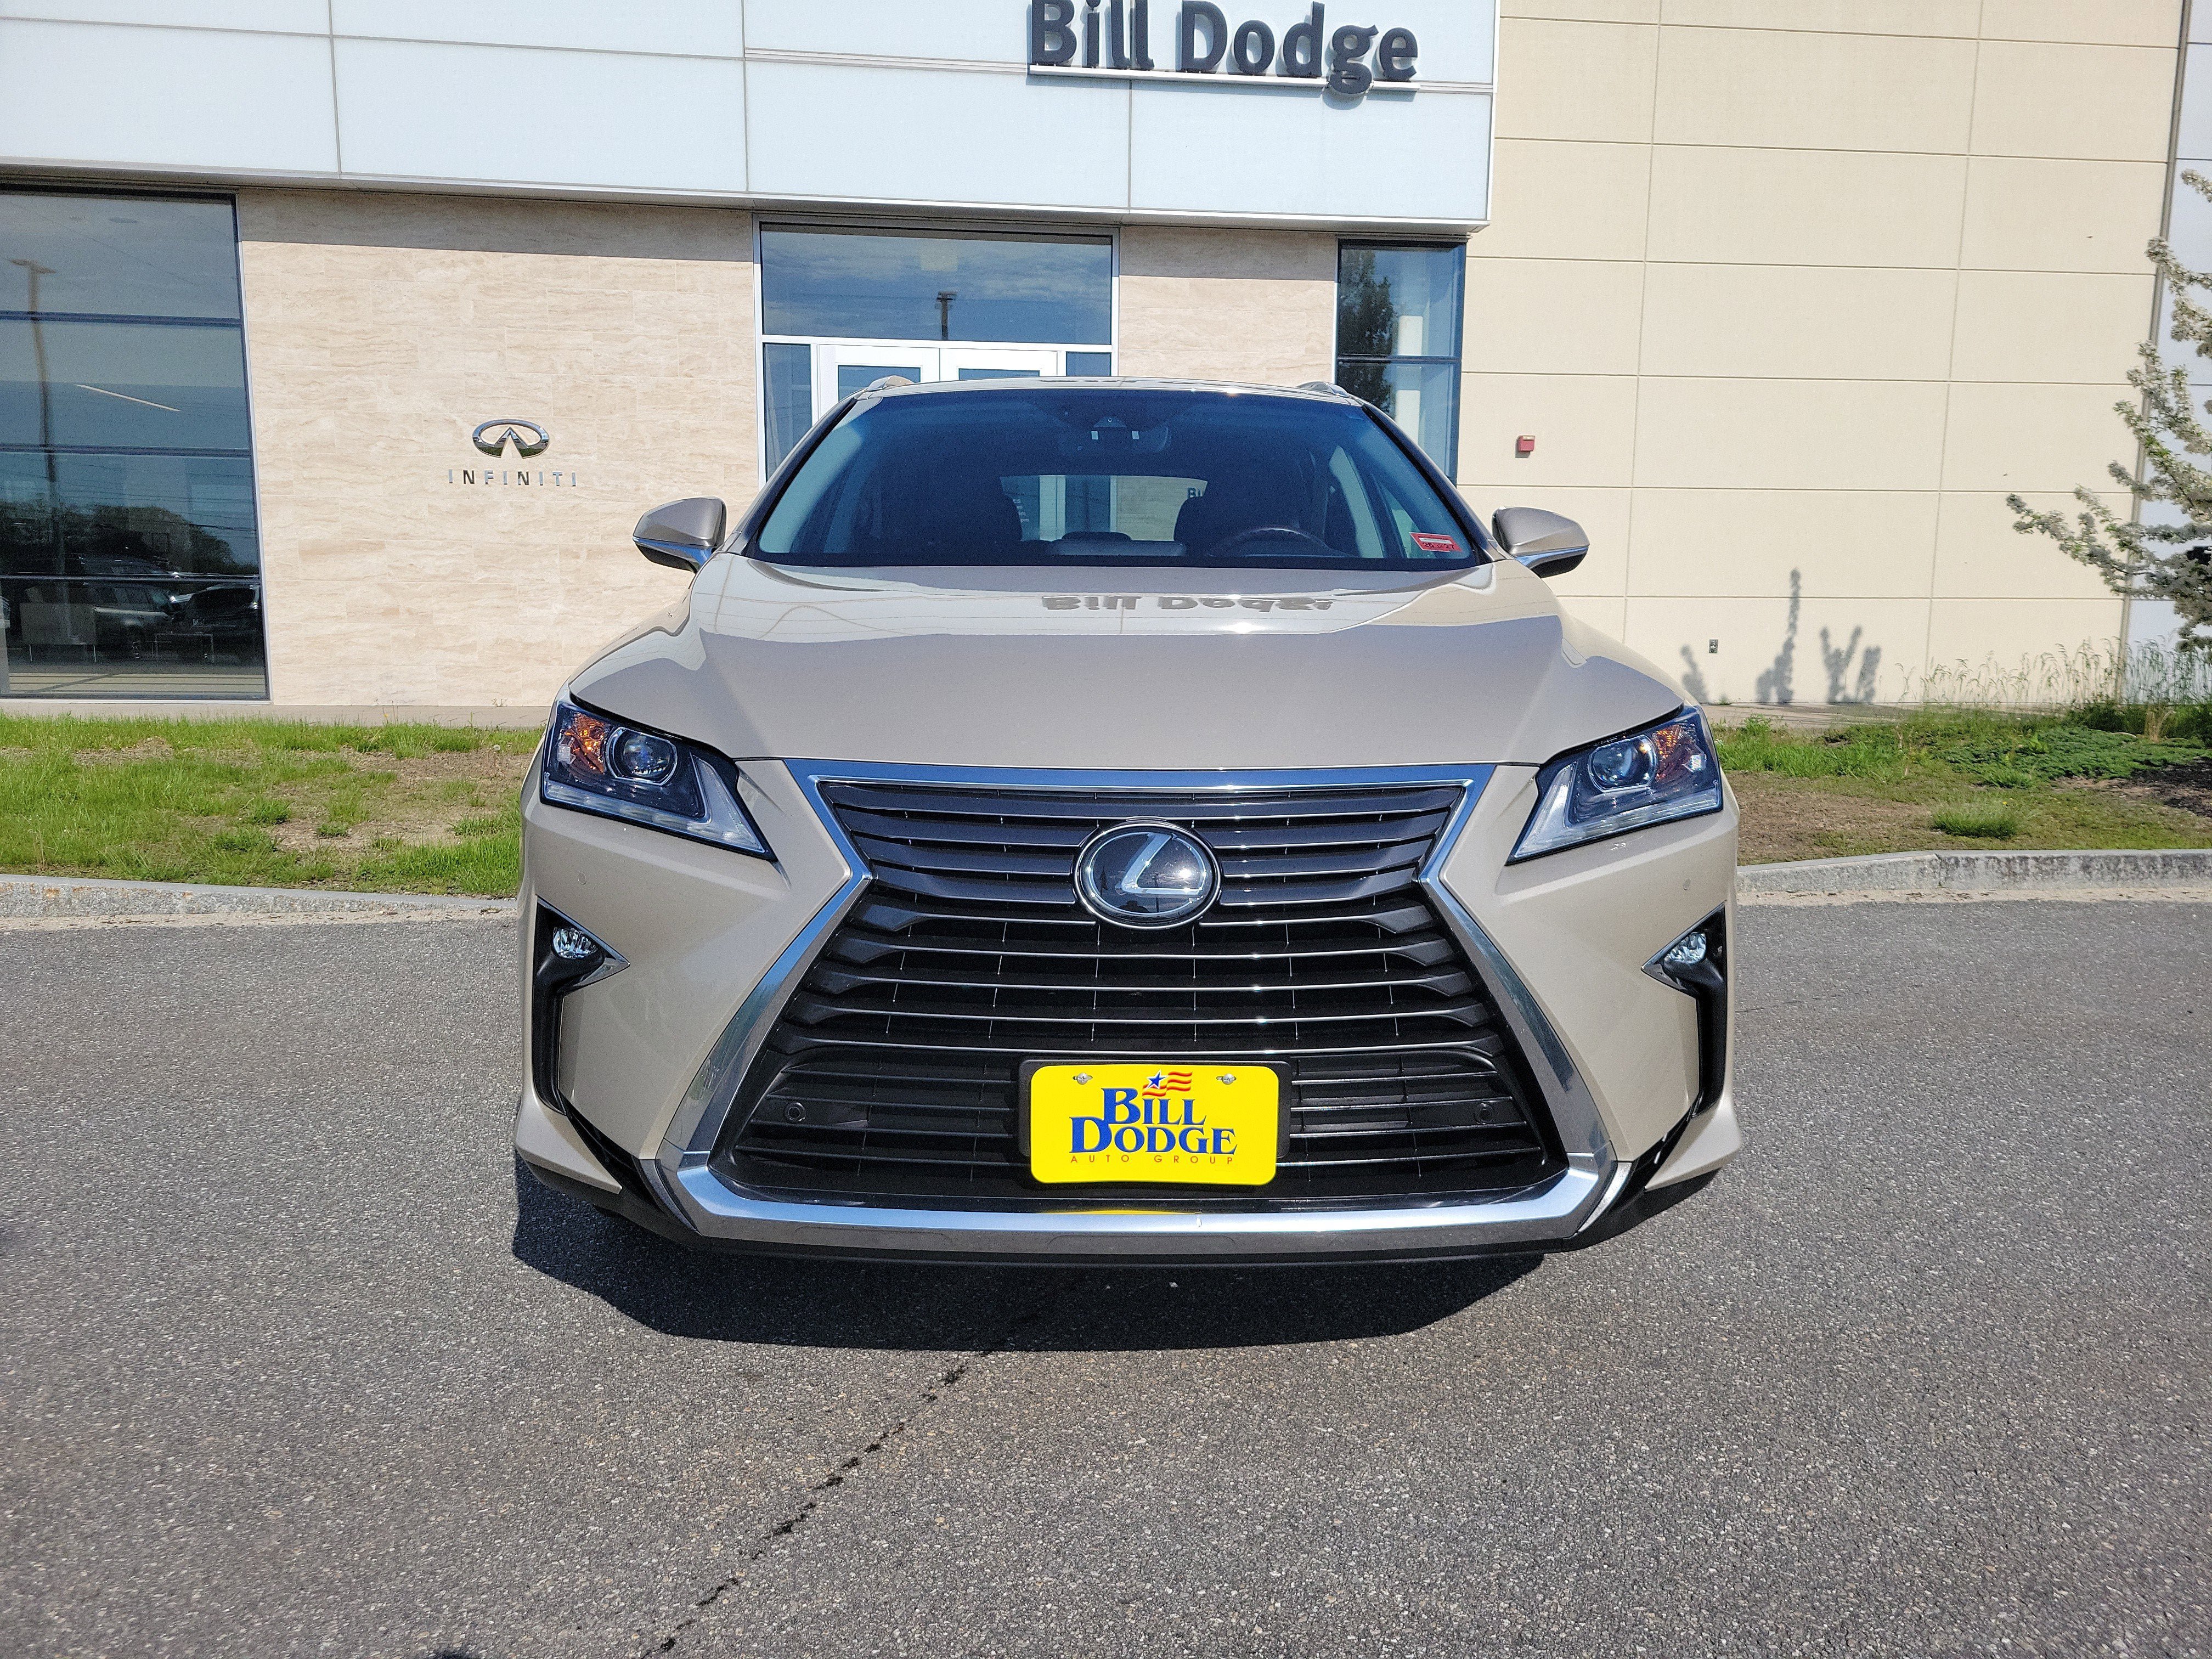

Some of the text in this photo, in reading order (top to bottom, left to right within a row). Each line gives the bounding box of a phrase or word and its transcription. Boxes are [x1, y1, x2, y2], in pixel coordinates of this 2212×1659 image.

[1031, 0, 1418, 94] Bill Dodge
[448, 469, 577, 487] INFINITI
[1101, 1087, 1207, 1125] BILL
[1069, 1116, 1238, 1155] DODGE
[1070, 1154, 1233, 1164] AUTO GROUP
